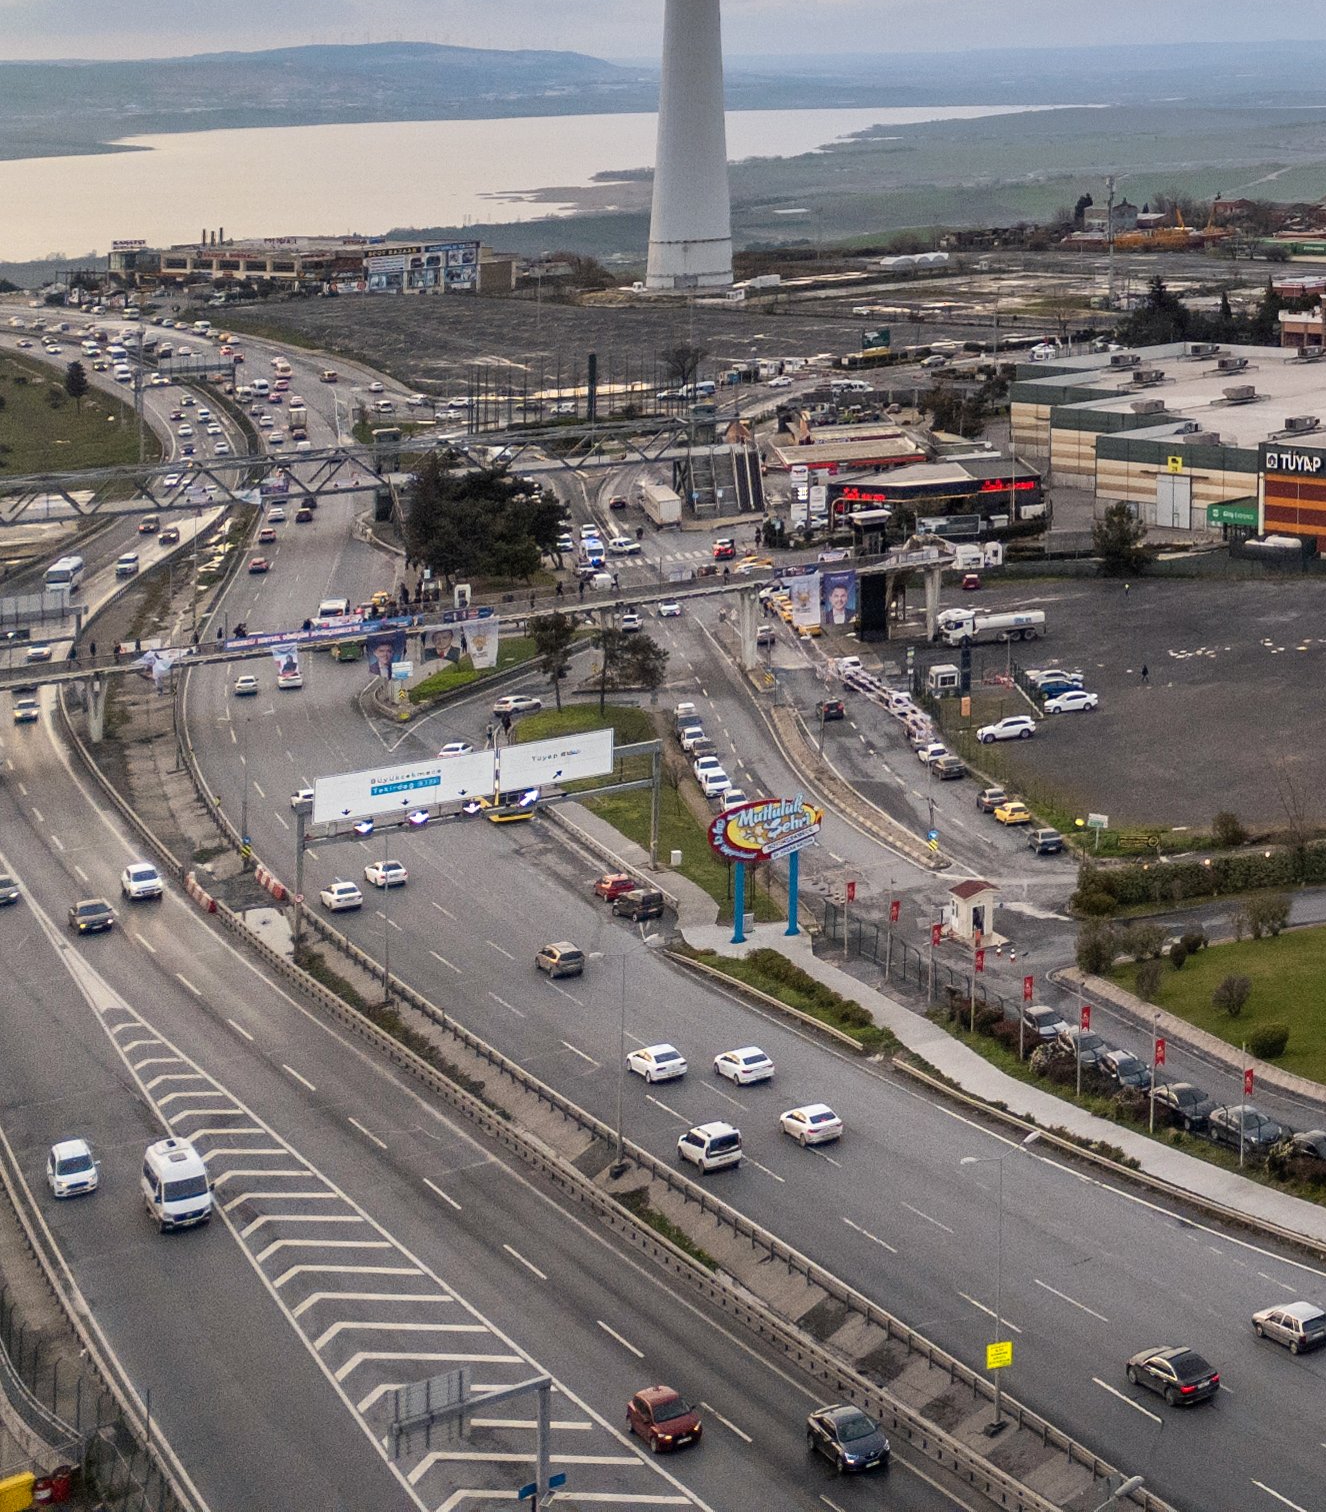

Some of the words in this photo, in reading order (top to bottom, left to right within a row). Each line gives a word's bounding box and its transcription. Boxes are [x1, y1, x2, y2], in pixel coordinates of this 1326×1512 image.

[1279, 450, 1322, 473] TÜYAP
[730, 792, 804, 827] Mutluluk
[763, 812, 811, 841] Şehri
